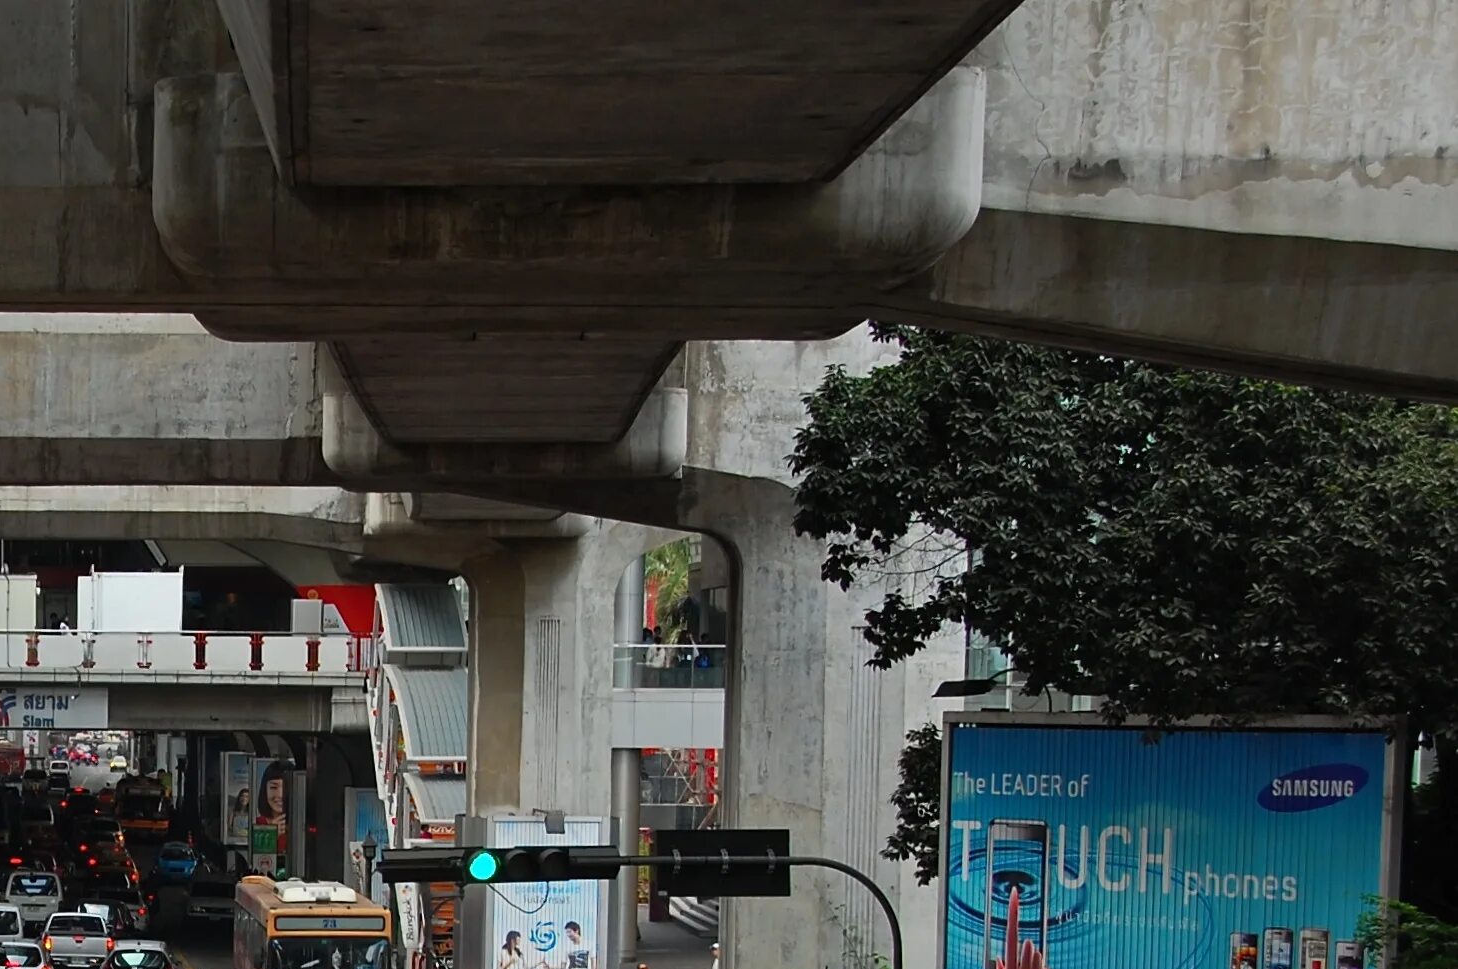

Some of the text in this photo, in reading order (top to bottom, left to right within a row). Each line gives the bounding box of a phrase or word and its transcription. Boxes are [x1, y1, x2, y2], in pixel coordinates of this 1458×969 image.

[23, 694, 69, 711] สยาม
[953, 771, 1090, 798] The LEADER of
[1271, 778, 1354, 797] SAMSUNG
[1184, 863, 1298, 905] phones
